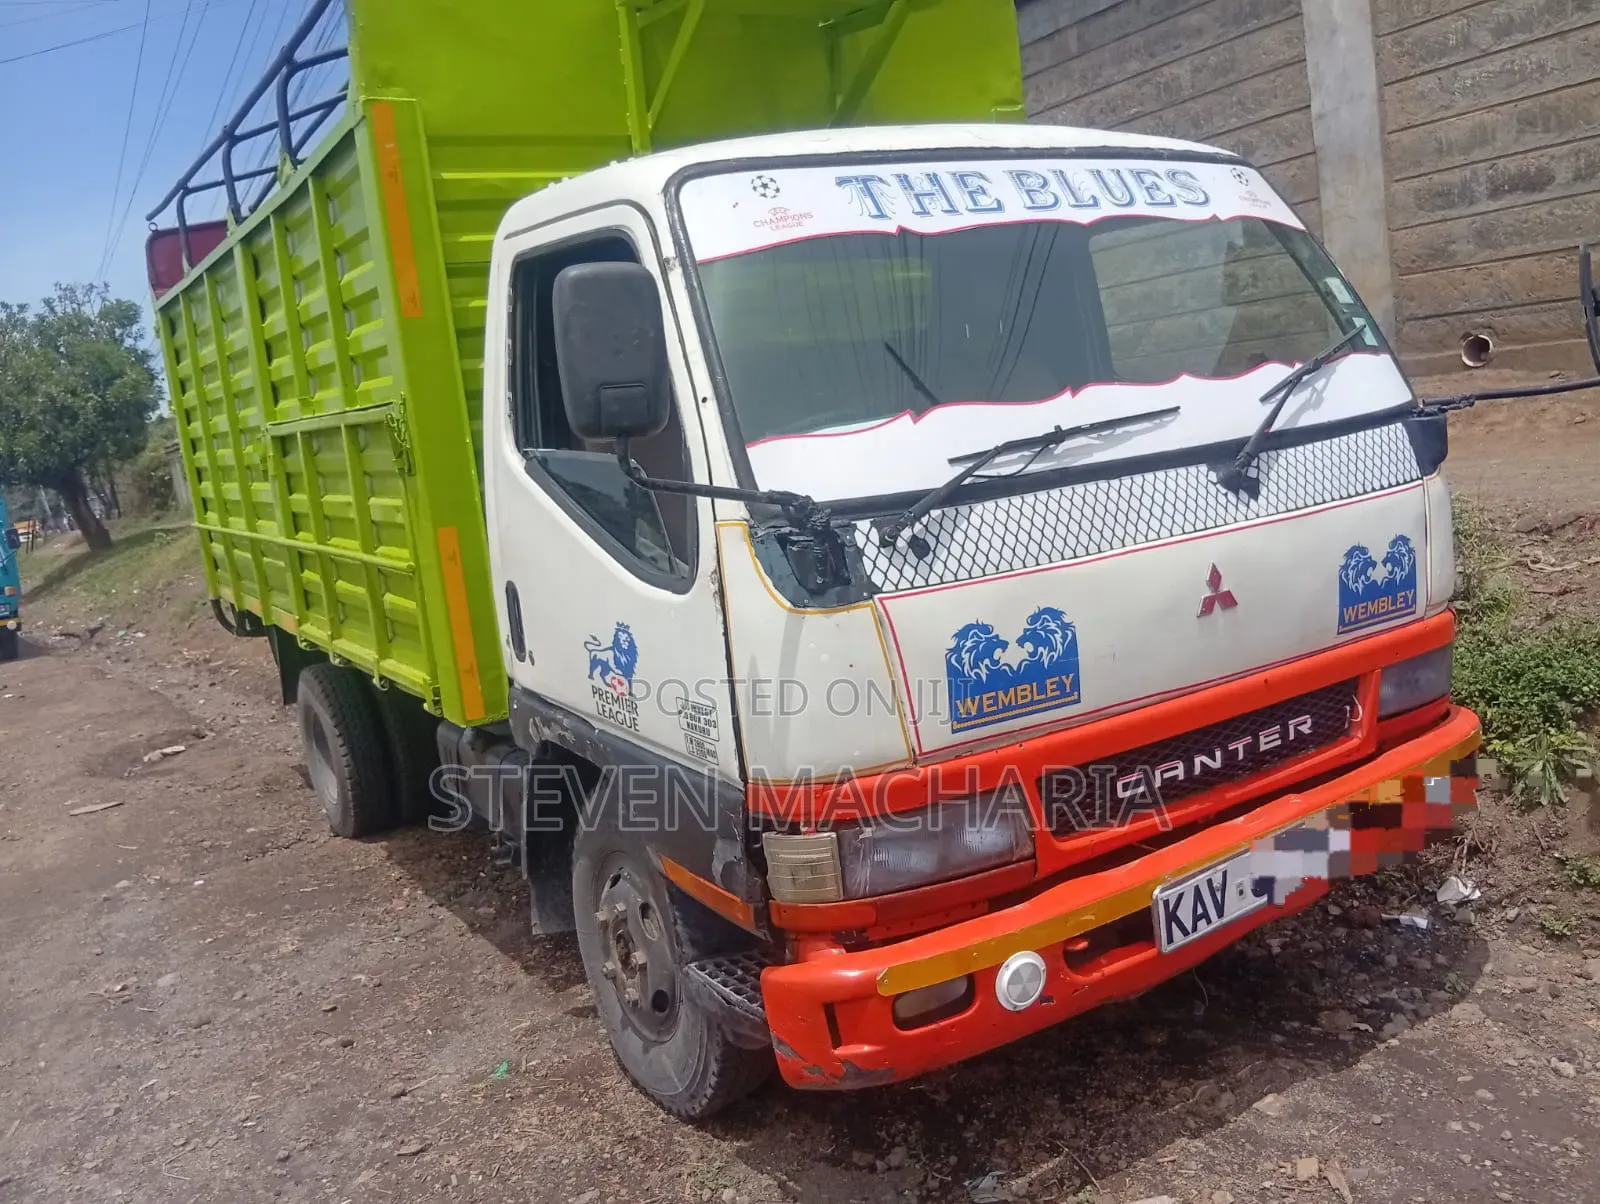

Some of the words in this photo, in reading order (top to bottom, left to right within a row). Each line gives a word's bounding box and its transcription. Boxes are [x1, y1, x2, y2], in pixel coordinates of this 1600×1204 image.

[835, 170, 1003, 219] THE
[1003, 167, 1212, 212] BLUES
[753, 211, 814, 228] CHAMPIONS
[770, 221, 805, 232] LEAGUE
[1343, 589, 1415, 623] WEMBLEY
[591, 684, 639, 716] PREMIER
[955, 672, 1075, 719] WEMBLEY
[596, 700, 640, 733] LEAGUE
[1116, 714, 1313, 799] CANTER
[1163, 869, 1228, 946] KAV
